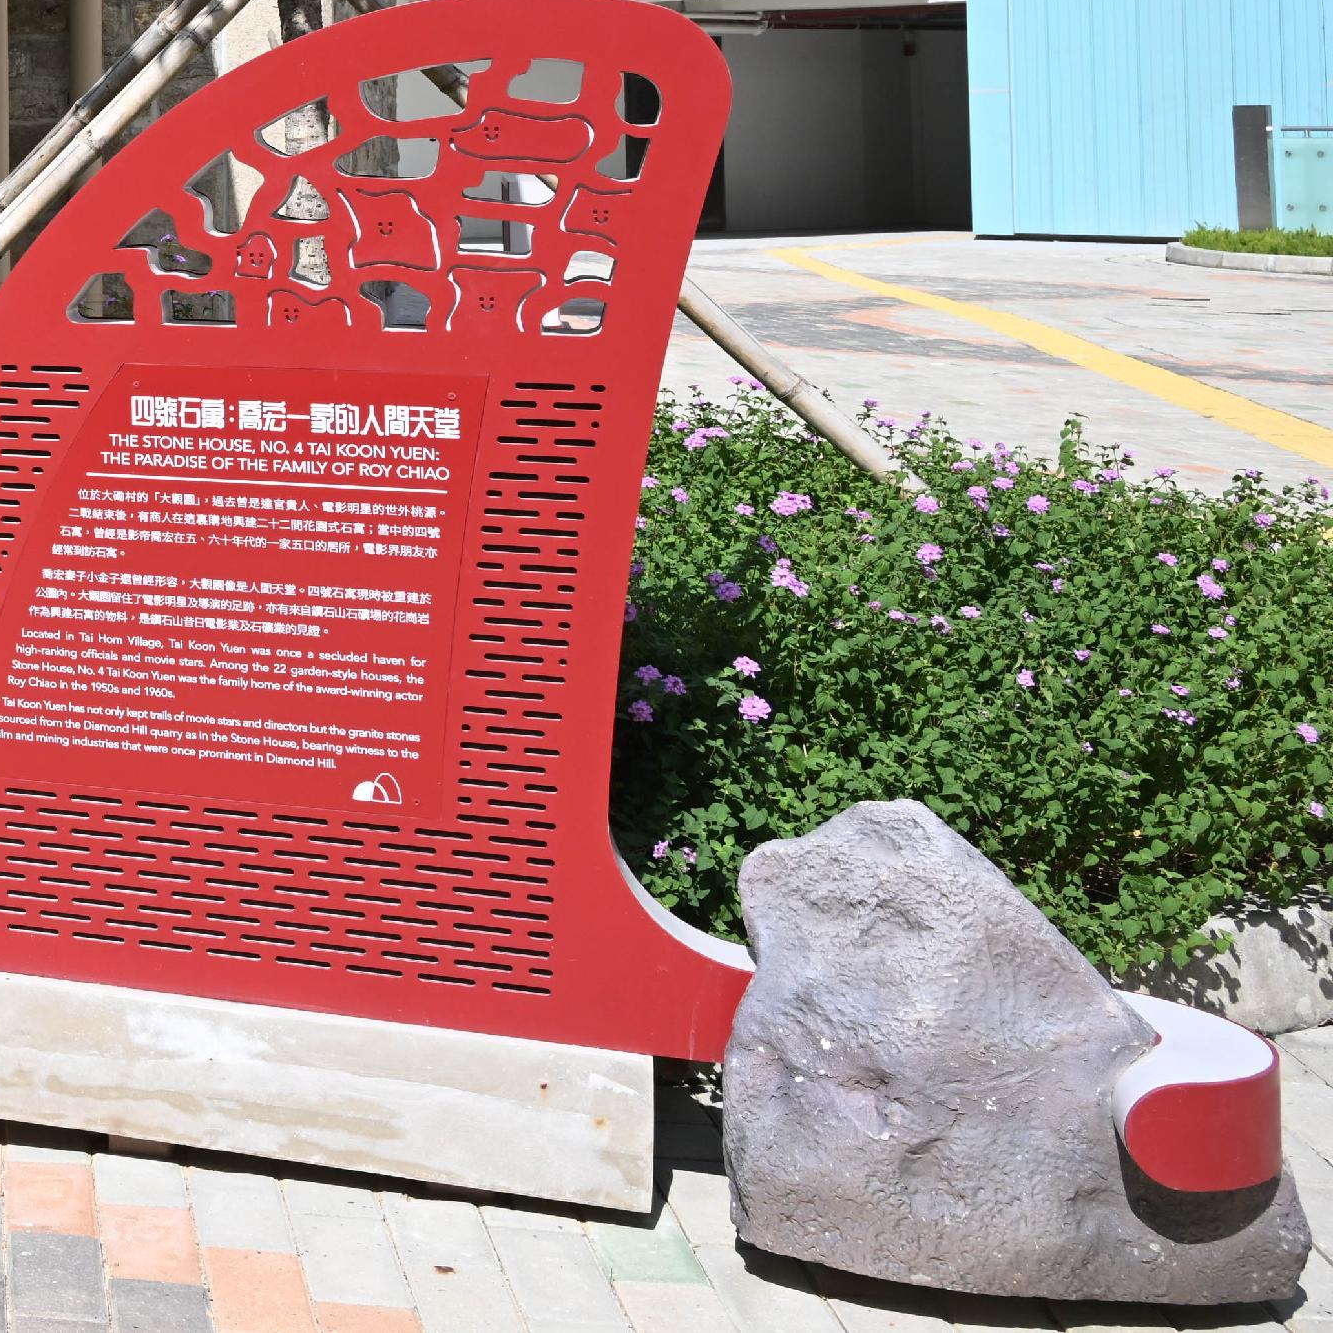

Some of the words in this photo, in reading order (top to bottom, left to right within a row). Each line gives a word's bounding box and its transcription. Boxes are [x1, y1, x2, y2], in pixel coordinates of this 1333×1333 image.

[100, 452, 130, 465] THE
[135, 453, 207, 469] PARADISE
[212, 457, 234, 470] OF
[237, 458, 268, 471] THE
[273, 460, 328, 474] FAMILY
[332, 462, 354, 475] OF
[359, 463, 392, 477] ROY
[396, 465, 450, 480] CHIAO
[109, 434, 139, 447] THE
[142, 435, 194, 449] STONE
[199, 438, 255, 454] HOUSE,
[261, 440, 290, 454] NO.
[294, 442, 304, 454] 4
[307, 442, 331, 456] TAI
[336, 444, 385, 458] KOON
[390, 446, 440, 460] YUEN:
[16, 643, 77, 660] high-ranking
[80, 649, 118, 660] officials
[122, 652, 141, 662] and
[145, 655, 175, 665] movie
[179, 658, 206, 667] stars.
[210, 658, 248, 673] Among
[252, 662, 269, 672] the
[274, 663, 286, 673] 22
[290, 666, 357, 680] garden-style
[361, 669, 402, 684] houses,
[406, 673, 424, 684] the
[22, 628, 60, 640] Located
[66, 631, 74, 640] in
[78, 632, 93, 642] Tai
[99, 633, 122, 644] Hom
[127, 636, 164, 649] Village,
[168, 638, 183, 649] Tai
[188, 640, 215, 651] Koon
[220, 642, 246, 653] Yuen
[251, 648, 271, 656] was
[276, 649, 302, 658] once
[319, 651, 368, 663] secluded
[373, 653, 405, 666] haven
[410, 656, 426, 667] for
[8, 675, 26, 688] Roy
[28, 677, 57, 688] Chiao
[60, 680, 68, 689] in
[71, 680, 88, 691] the
[91, 682, 119, 693] 1950s
[121, 685, 140, 695] and
[144, 686, 175, 698] 1960s.
[12, 659, 40, 670] Stone
[42, 662, 75, 675] House,
[78, 665, 95, 675] No.
[98, 666, 104, 676] 4
[106, 667, 120, 677] Tai
[122, 668, 149, 679] Koon
[151, 670, 175, 681] Yuen
[177, 675, 197, 683] was
[199, 674, 216, 685] the
[218, 675, 249, 690] family
[251, 678, 281, 690] home
[283, 681, 294, 691] of
[296, 682, 313, 693] the
[316, 685, 392, 702] award-winning
[395, 692, 423, 701] actor
[2, 697, 15, 707] Tai
[17, 698, 42, 709] Koon
[43, 700, 67, 711] Yuen
[69, 702, 85, 713] has
[87, 706, 103, 715] not
[104, 706, 125, 719] only
[126, 707, 148, 721] kept
[150, 710, 172, 721] trails
[173, 711, 184, 722] of
[186, 715, 216, 724] movie
[217, 717, 241, 726] stars
[243, 719, 262, 728] and
[264, 719, 308, 732] directors
[310, 722, 328, 734] but
[328, 724, 346, 735] the
[348, 729, 384, 739] granite
[386, 732, 420, 742] stones
[39, 715, 62, 728] from
[64, 719, 81, 729] the
[84, 720, 129, 733] Diamond
[132, 724, 147, 735] Hill
[150, 729, 183, 741] quarry
[199, 731, 208, 741] in
[210, 731, 228, 742] the
[230, 733, 261, 745] Stone
[263, 736, 299, 750] House,
[302, 739, 343, 755] bearing
[345, 744, 385, 756] witness
[387, 748, 398, 757] to
[401, 748, 419, 759] the
[15, 732, 34, 741] and
[36, 733, 69, 746] mining
[72, 736, 119, 749] industries
[121, 740, 142, 751] that
[144, 744, 168, 753] were
[171, 747, 196, 756] once
[199, 750, 252, 761] prominent
[254, 752, 263, 762] in
[266, 753, 314, 767] Diamond
[317, 758, 336, 769] Hill.
